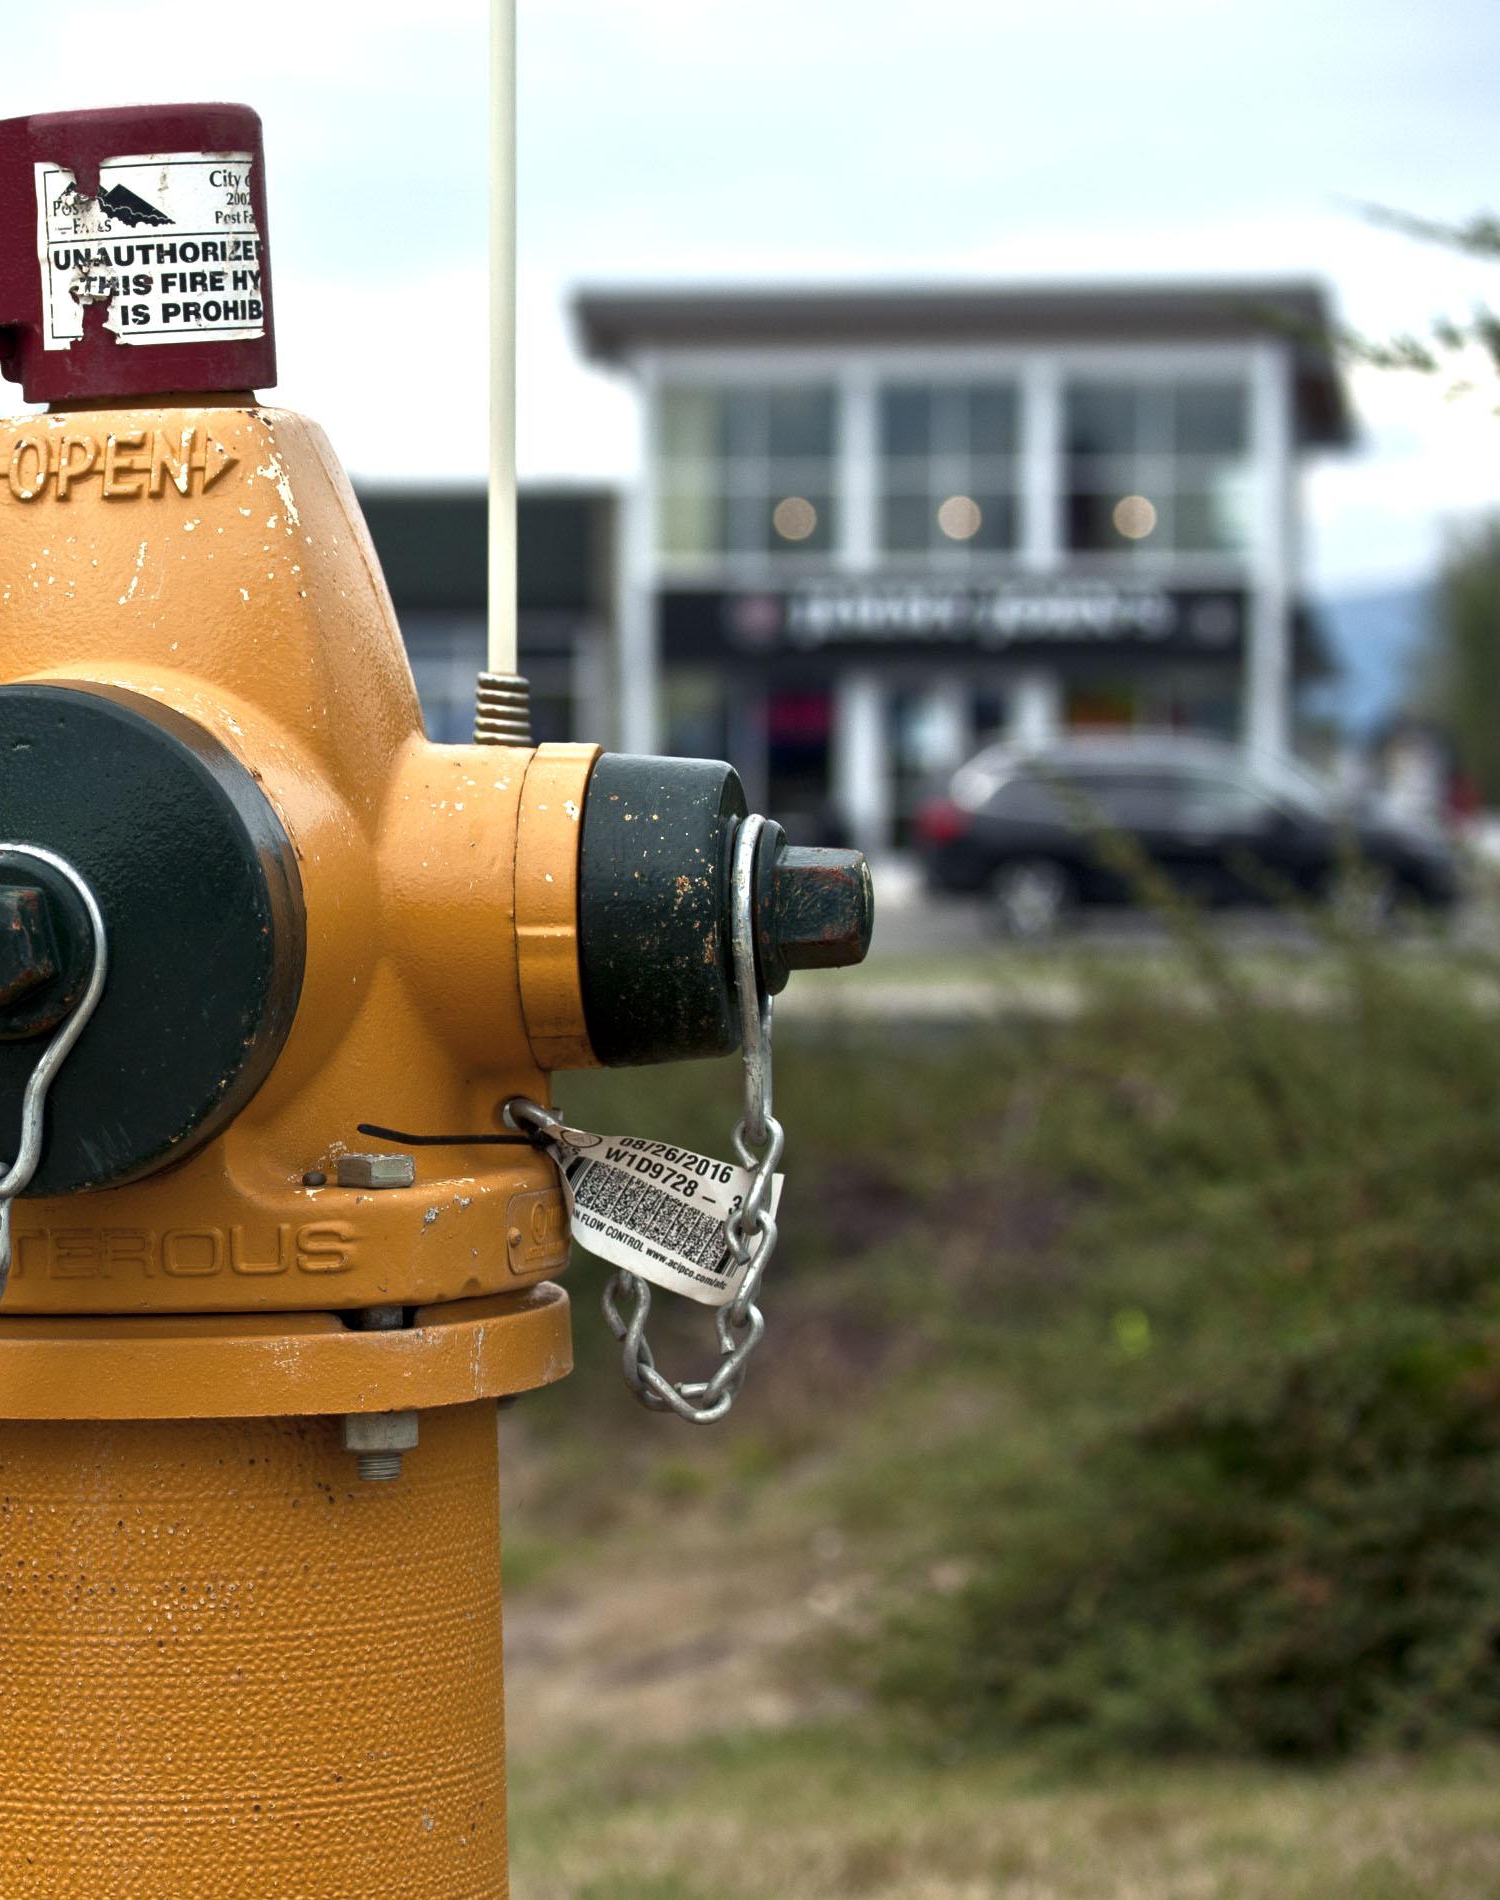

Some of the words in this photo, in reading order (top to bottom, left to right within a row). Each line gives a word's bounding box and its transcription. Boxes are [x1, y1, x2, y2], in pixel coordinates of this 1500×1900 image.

[209, 169, 241, 193] City
[215, 210, 241, 224] Post
[160, 271, 225, 294] FIRE
[121, 304, 151, 326] IS
[161, 299, 263, 324] PROHIB
[8, 427, 199, 502] OPEN
[604, 1147, 699, 1198] W1D9728
[619, 1137, 735, 1184] 08/26/2016
[580, 1212, 607, 1232] FLOW
[605, 1225, 645, 1252] CONTROL
